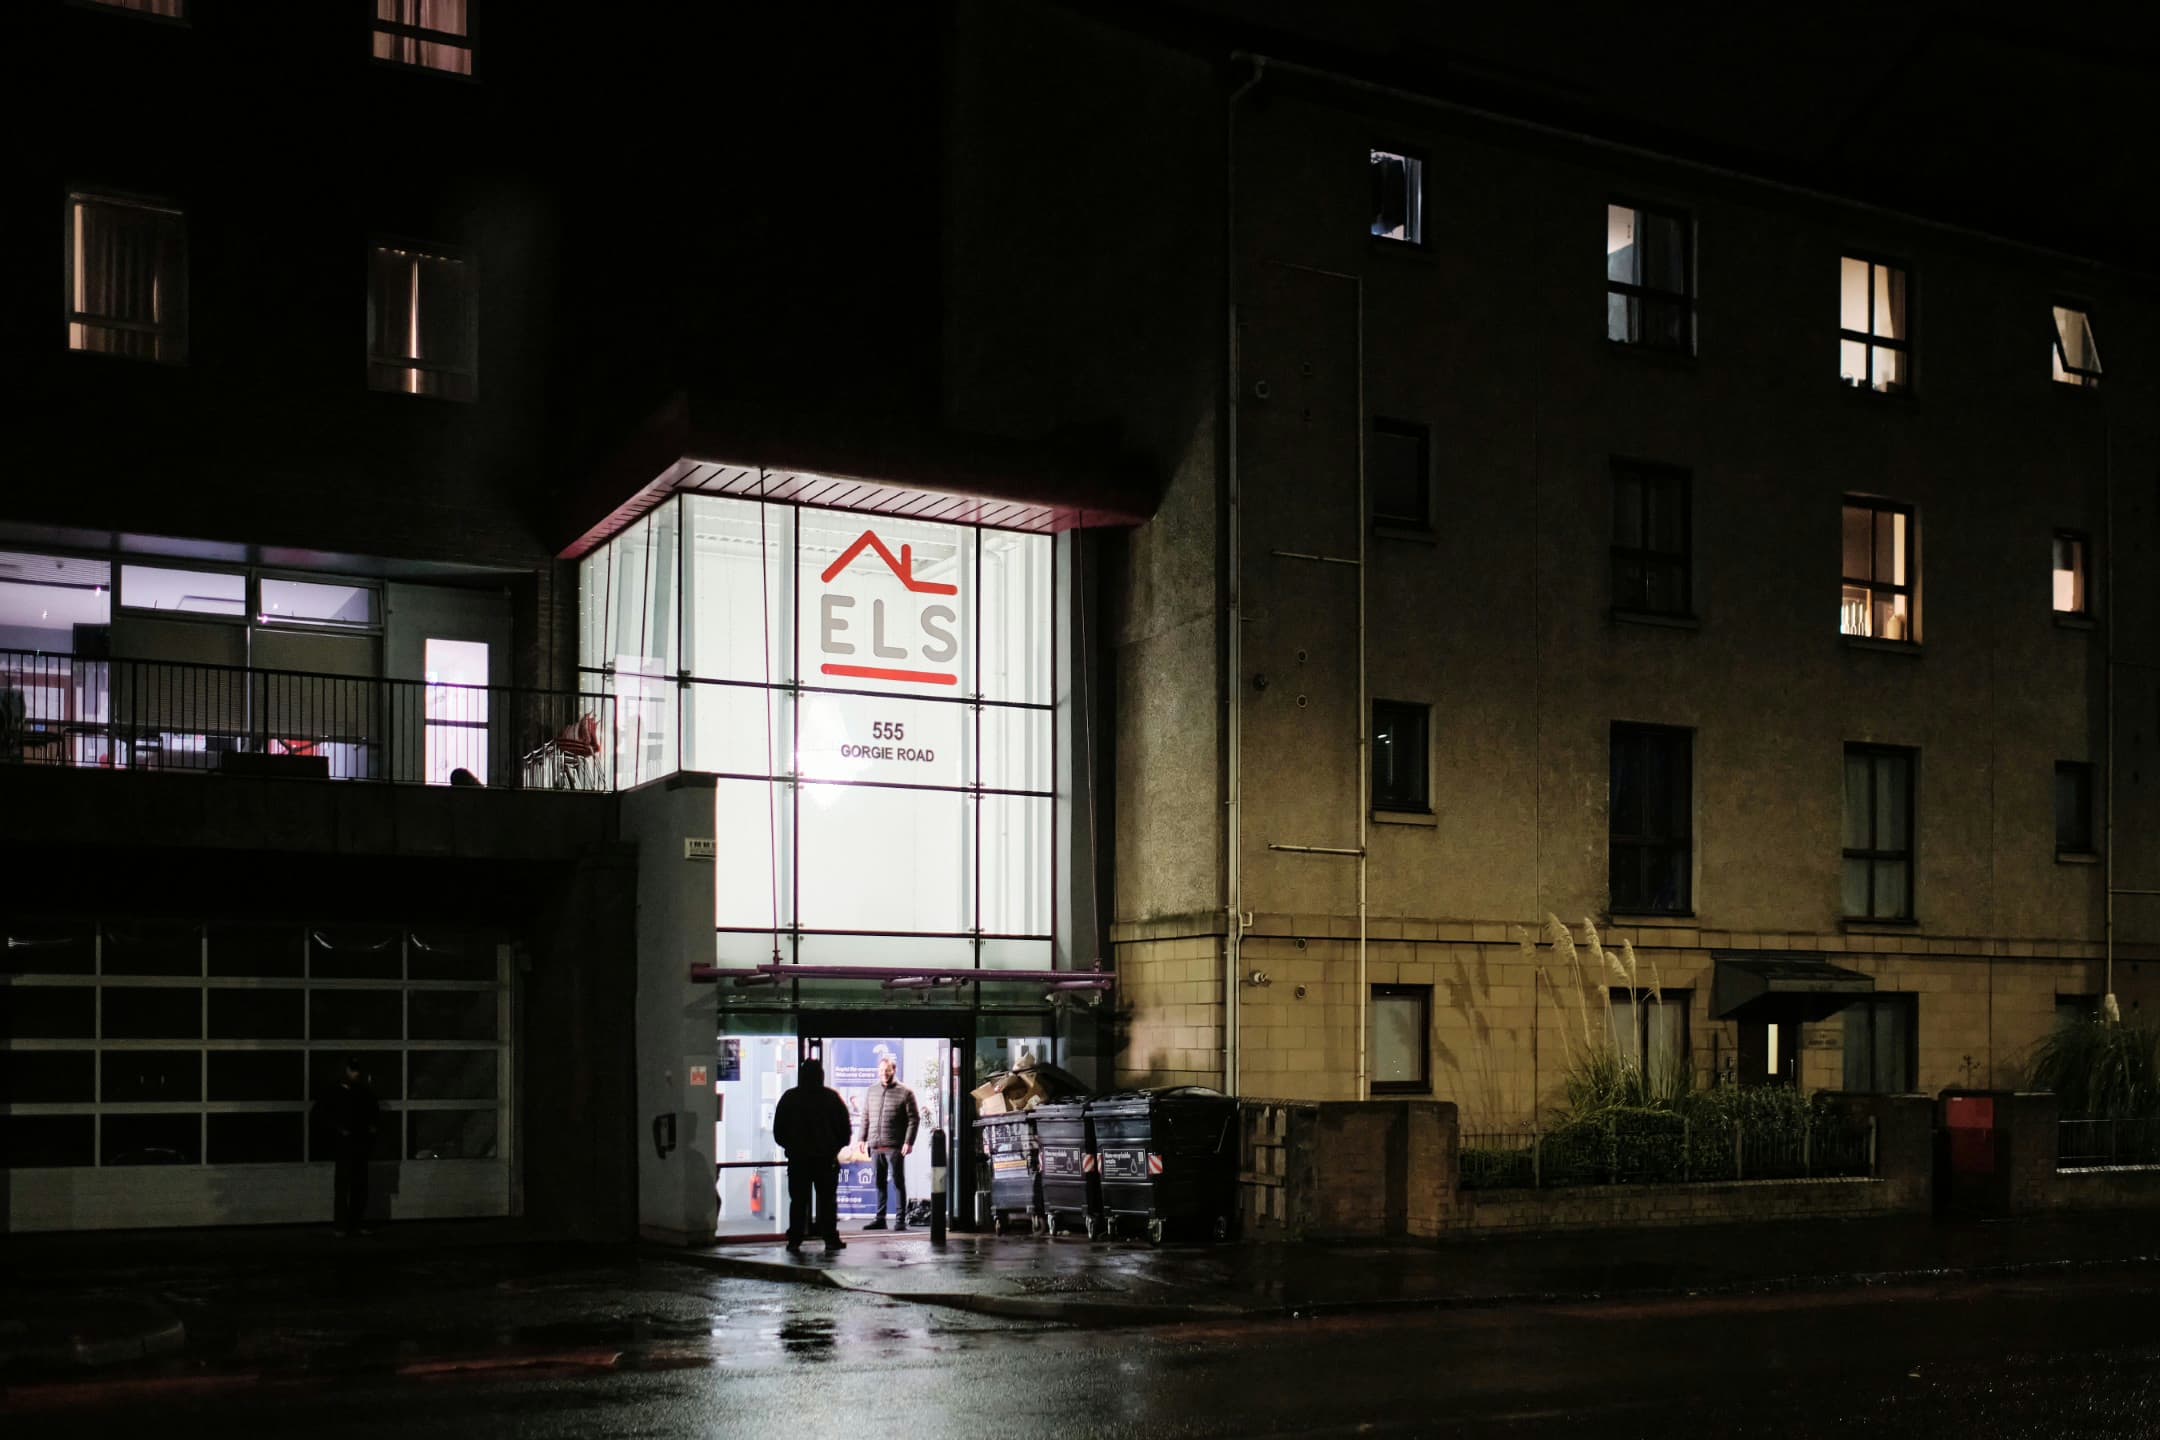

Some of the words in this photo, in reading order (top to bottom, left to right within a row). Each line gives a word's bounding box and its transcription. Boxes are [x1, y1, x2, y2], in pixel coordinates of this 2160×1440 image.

[821, 594, 957, 663] ELS
[872, 721, 904, 741] 555
[840, 744, 894, 760] GORGIE
[897, 748, 935, 762] ROAD
